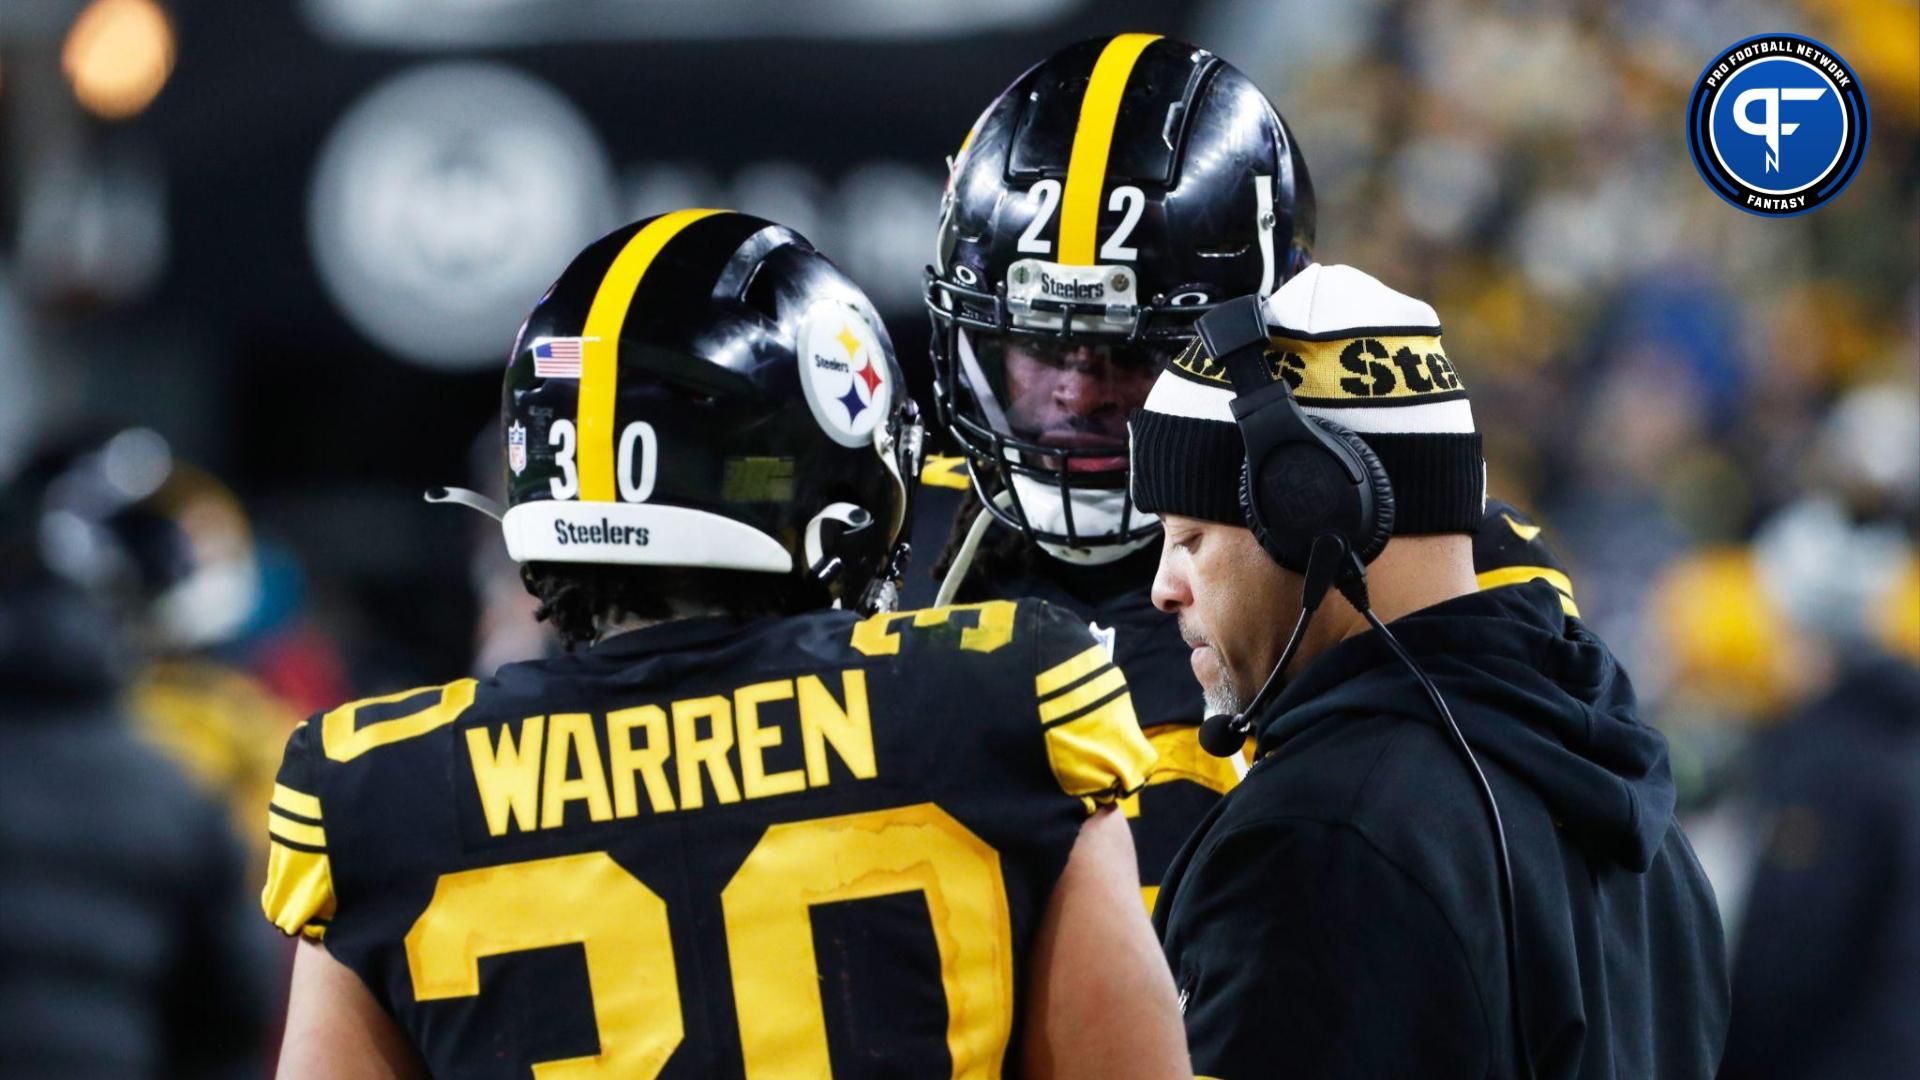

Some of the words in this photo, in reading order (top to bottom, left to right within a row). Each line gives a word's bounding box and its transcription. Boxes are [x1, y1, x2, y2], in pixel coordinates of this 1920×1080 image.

[1041, 274, 1104, 298] Steelers
[814, 354, 850, 374] Steelers
[554, 518, 649, 547] Steelers
[466, 669, 878, 836] WARREN
